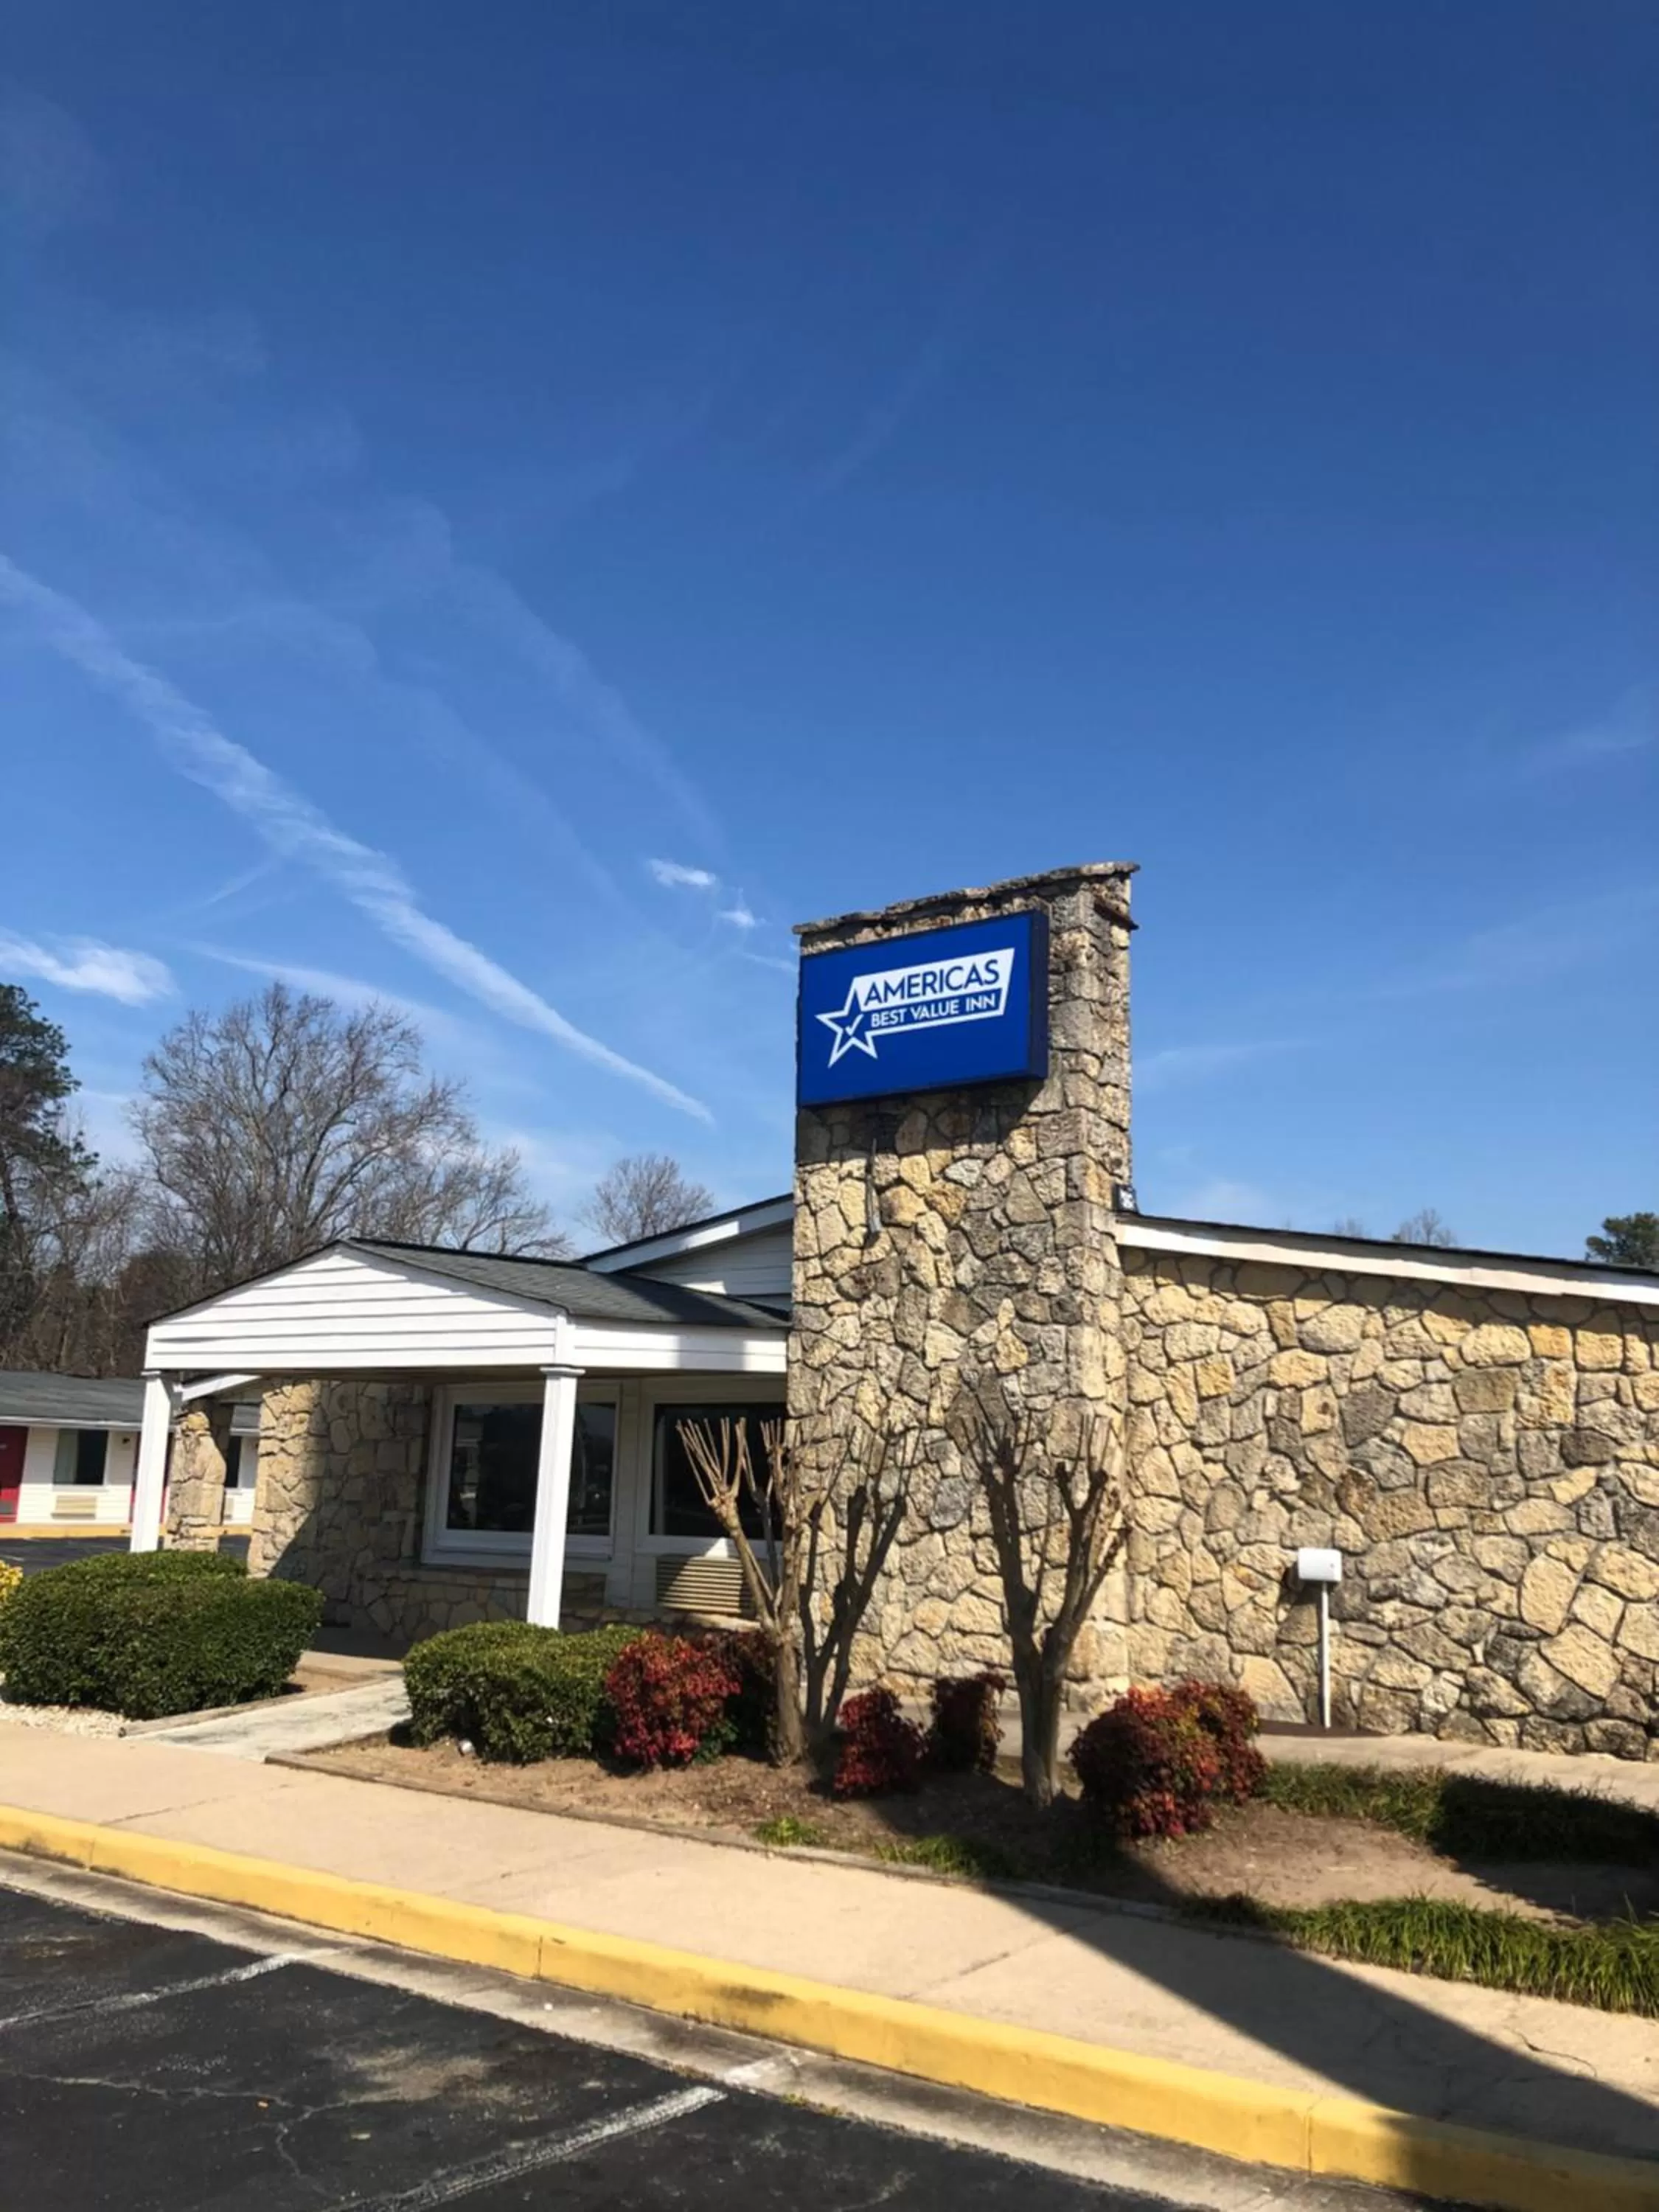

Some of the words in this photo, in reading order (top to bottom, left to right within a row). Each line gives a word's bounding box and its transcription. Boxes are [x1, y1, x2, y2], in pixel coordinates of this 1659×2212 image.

[863, 959, 1000, 1006] AMERICAS
[871, 1009, 905, 1028] BEST
[911, 999, 959, 1020] VALUE
[965, 992, 996, 1012] INN
